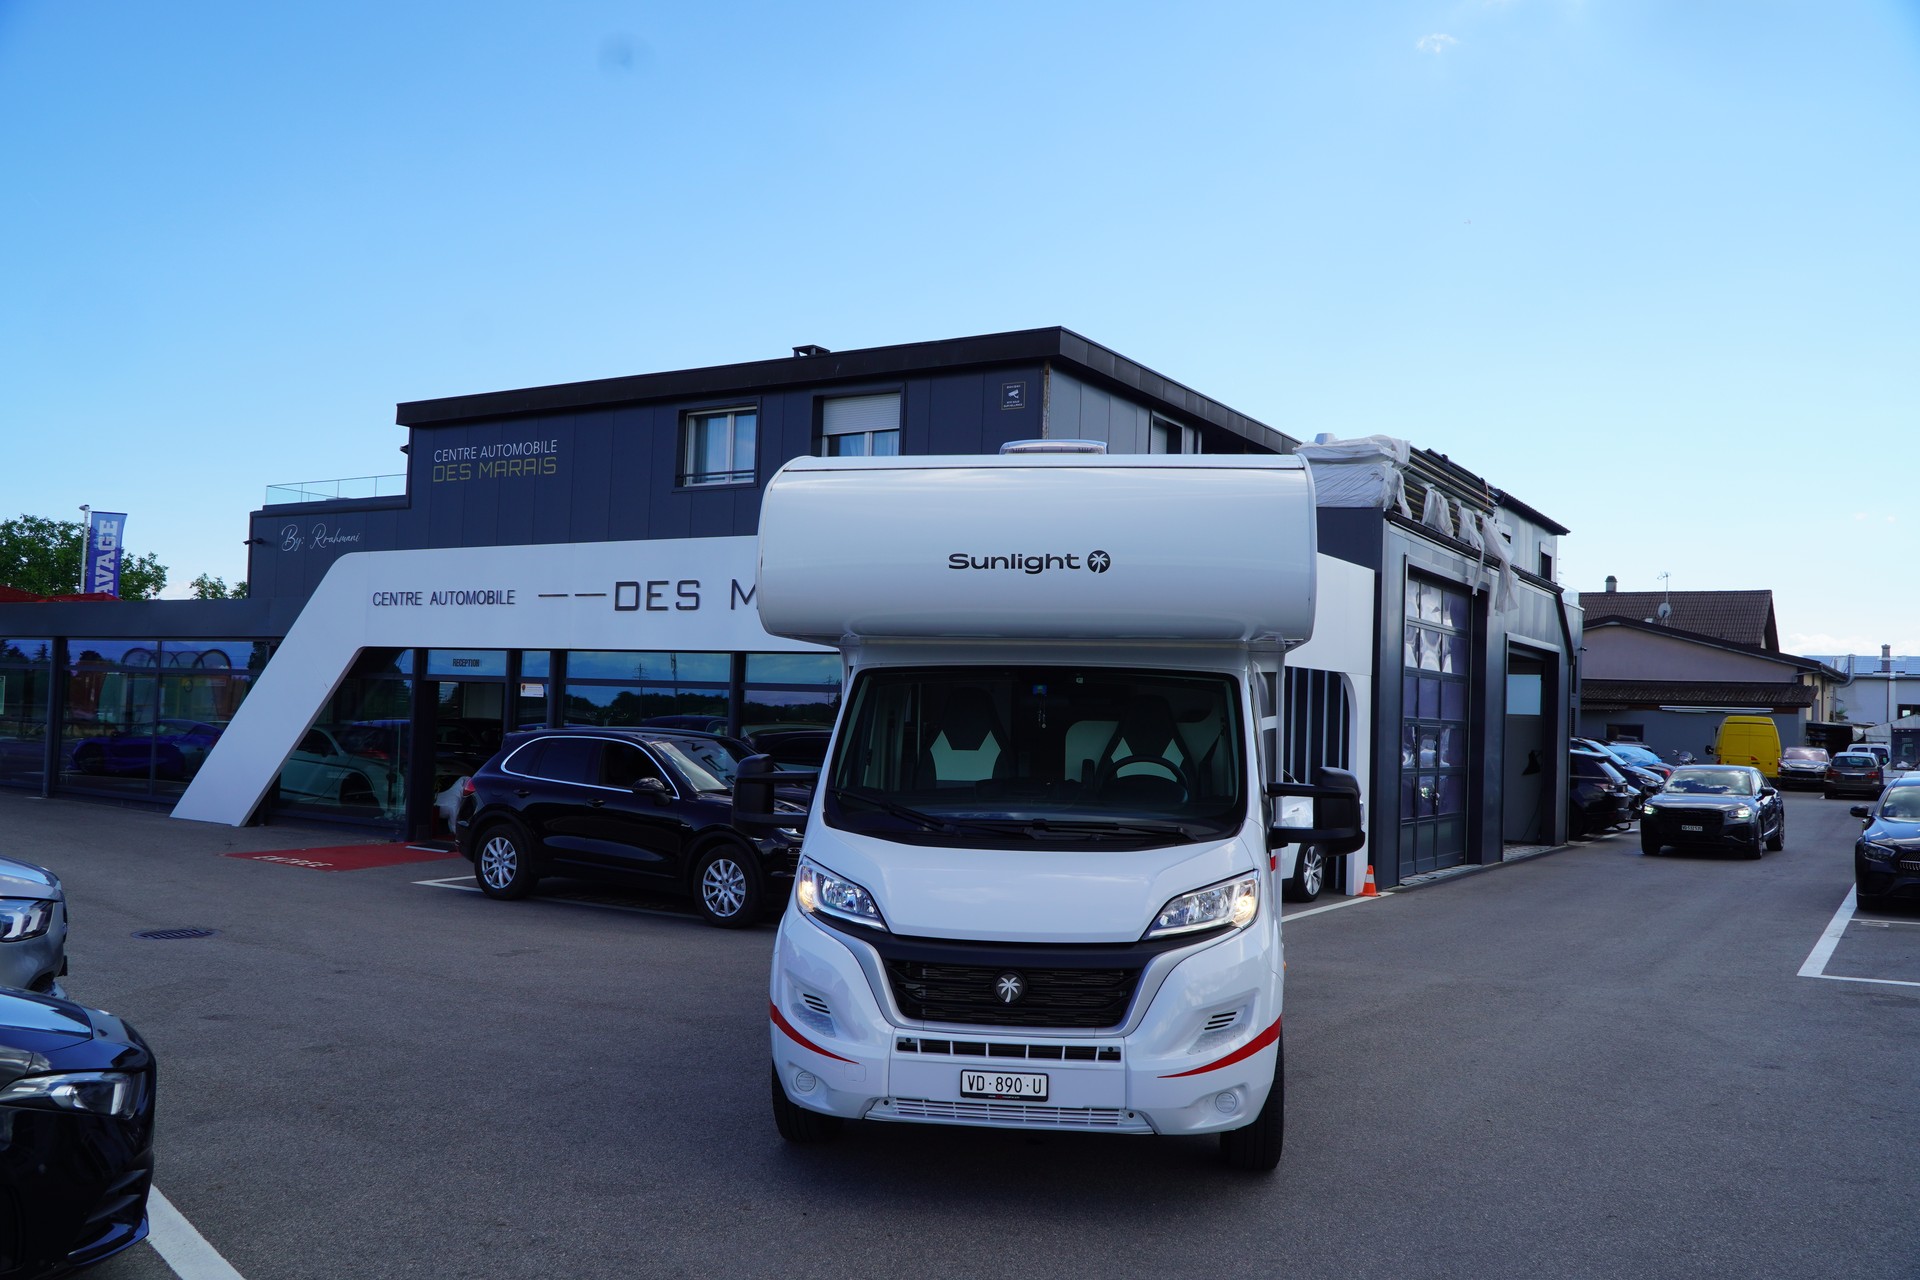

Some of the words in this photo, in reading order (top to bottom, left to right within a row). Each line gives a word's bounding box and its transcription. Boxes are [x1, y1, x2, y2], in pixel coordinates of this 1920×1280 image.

[434, 446, 477, 463] CENTRE
[480, 439, 557, 459] AUTOMOBILE
[432, 463, 471, 482] DES
[478, 456, 557, 479] MARAIS
[948, 553, 1081, 574] Sunlight
[372, 591, 423, 607] CENTRE
[429, 589, 516, 606] AUTOMOBILE
[614, 579, 701, 611] DES
[452, 658, 480, 668] RECEPTION
